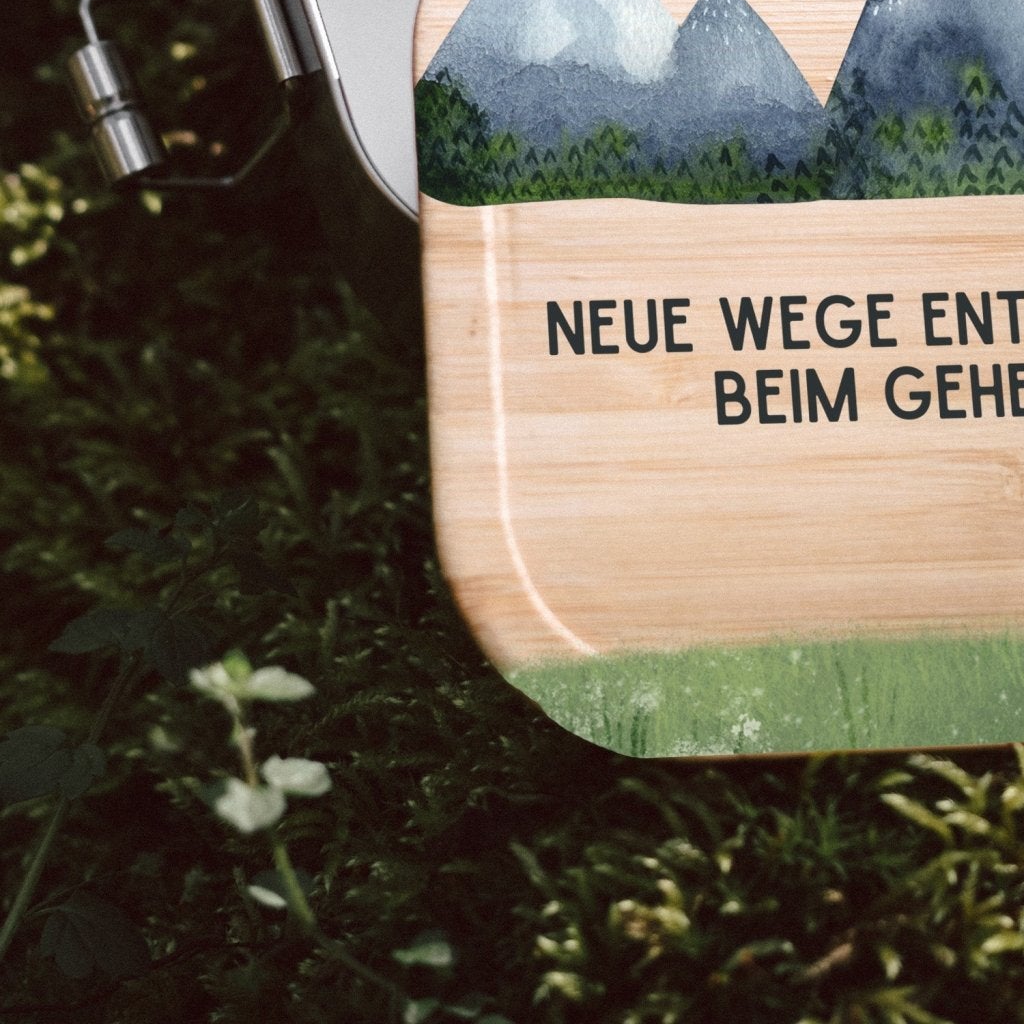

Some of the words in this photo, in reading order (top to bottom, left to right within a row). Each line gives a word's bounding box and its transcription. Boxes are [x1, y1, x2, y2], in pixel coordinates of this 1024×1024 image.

[546, 298, 694, 356] NEUE
[719, 293, 898, 351] WEGE
[714, 367, 858, 426] BEIM
